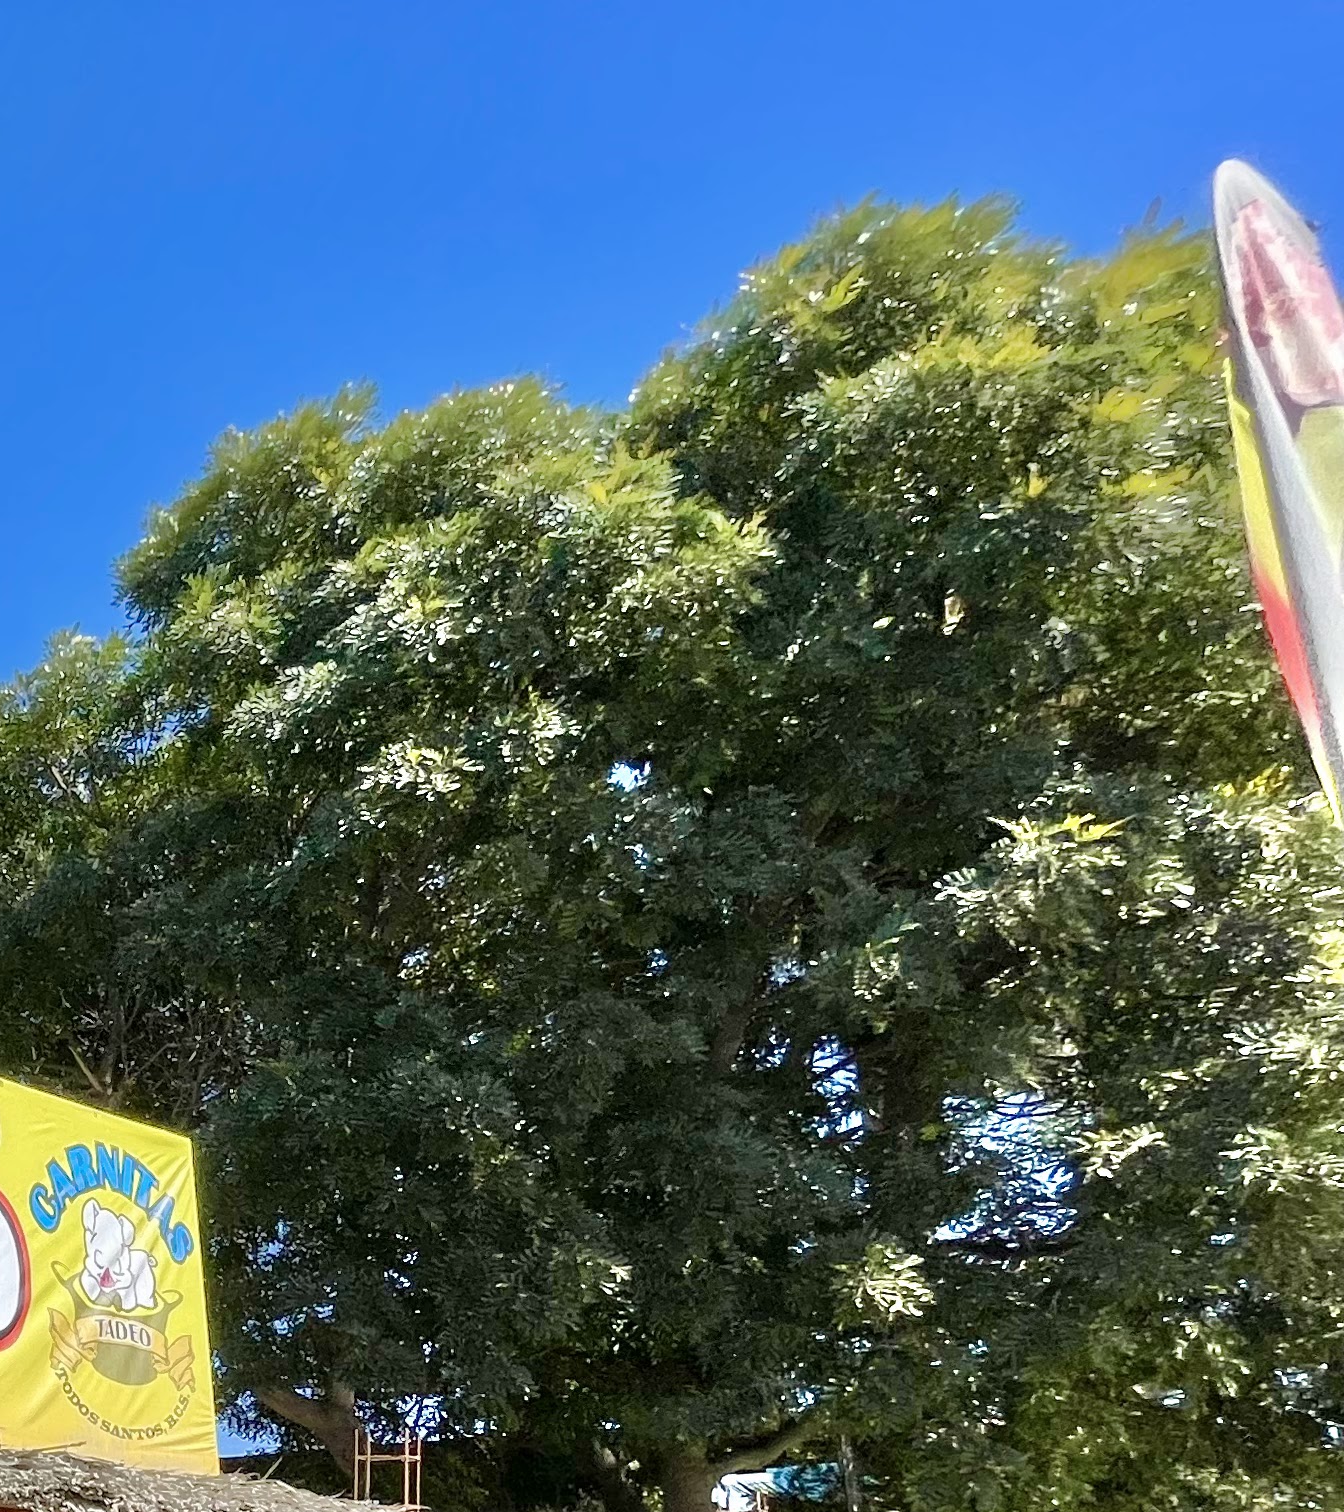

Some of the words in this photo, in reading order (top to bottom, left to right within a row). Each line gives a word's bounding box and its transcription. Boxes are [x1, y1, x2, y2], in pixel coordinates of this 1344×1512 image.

[29, 1140, 194, 1265] CARNITAS
[95, 1318, 152, 1347] TADEO
[55, 1367, 100, 1425] TODOS
